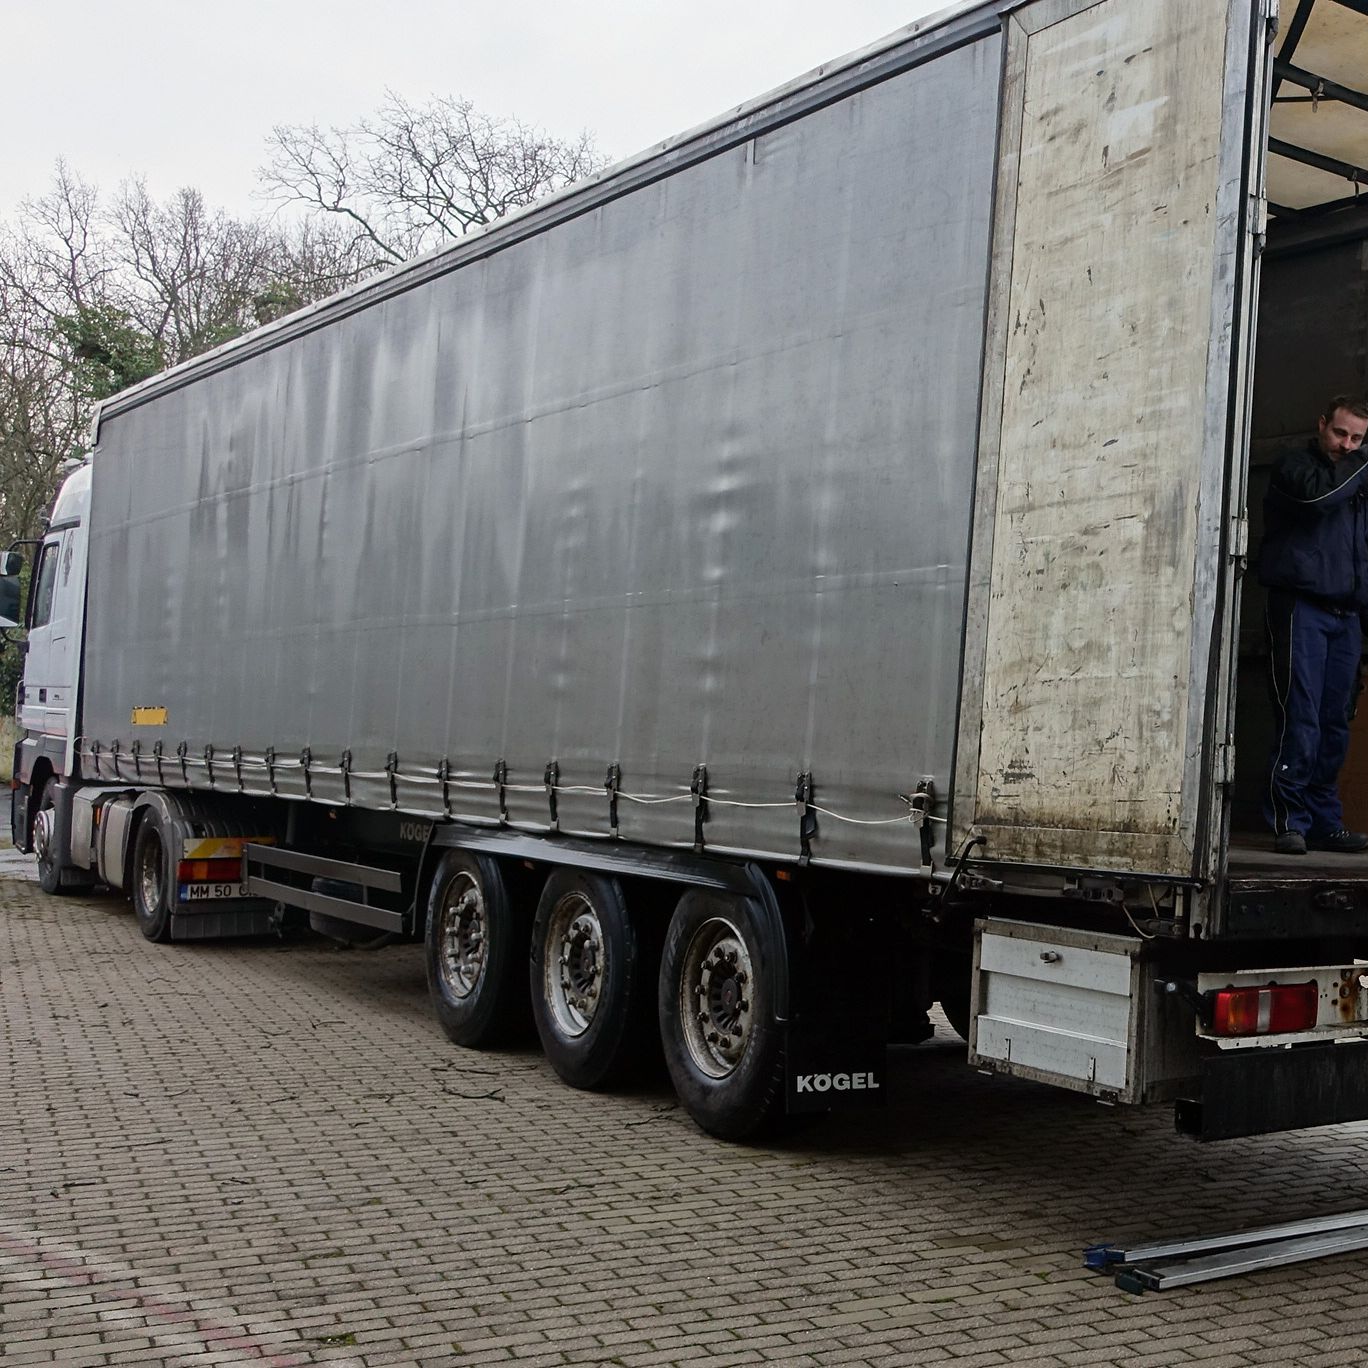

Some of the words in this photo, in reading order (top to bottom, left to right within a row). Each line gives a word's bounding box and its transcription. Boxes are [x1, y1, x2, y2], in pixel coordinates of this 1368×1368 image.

[190, 885, 210, 899] MM
[214, 884, 232, 898] 50
[796, 1072, 880, 1093] KÖGEL
